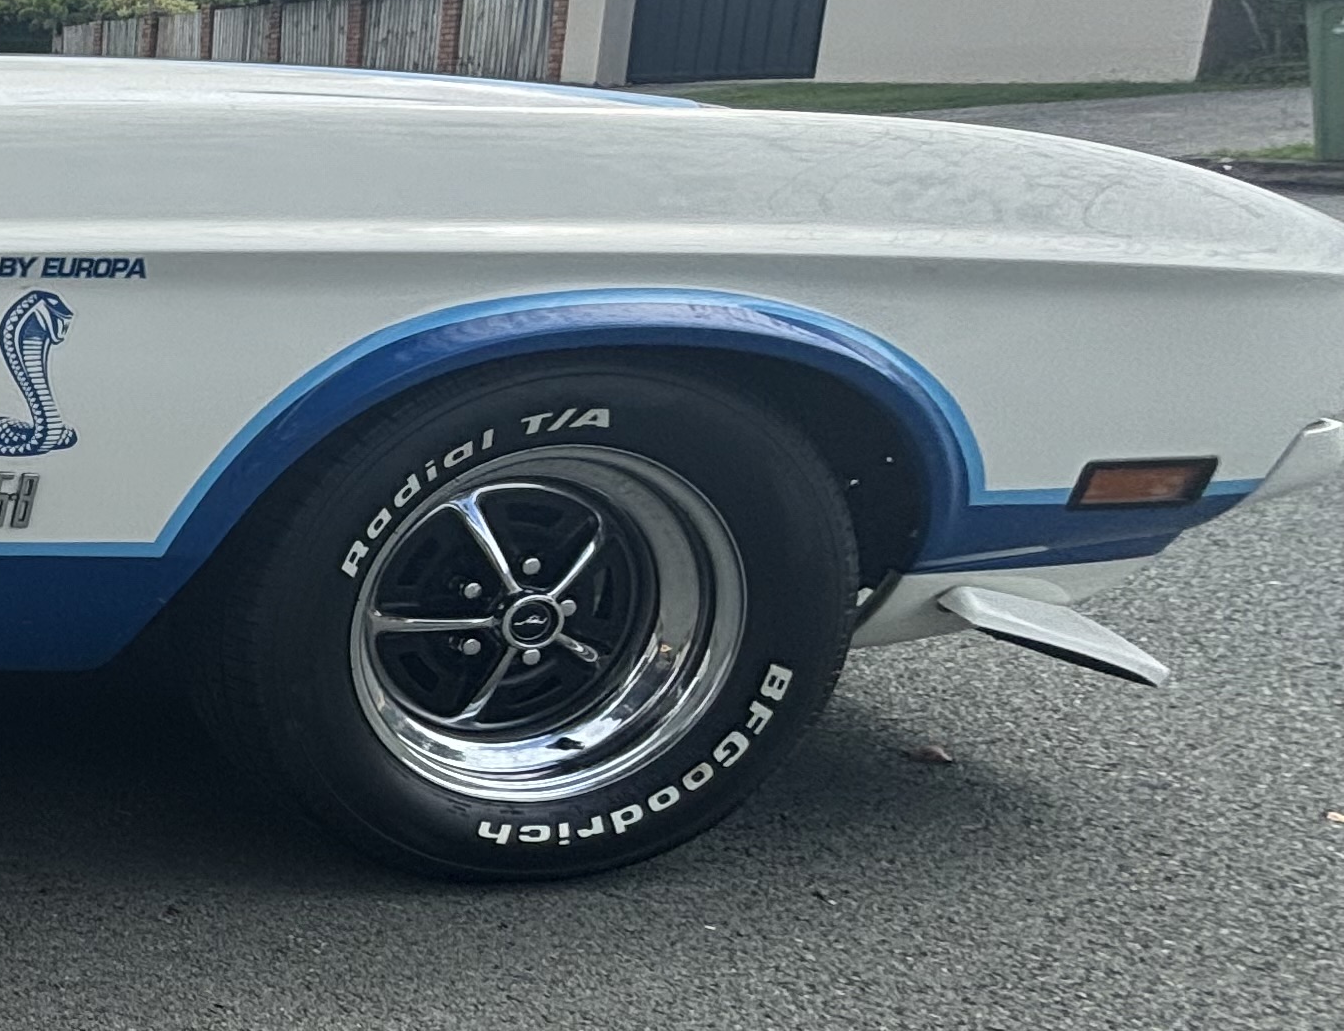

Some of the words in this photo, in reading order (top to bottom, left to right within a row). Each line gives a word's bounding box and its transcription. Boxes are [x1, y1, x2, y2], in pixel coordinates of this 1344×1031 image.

[40, 257, 146, 279] EUROPA
[341, 428, 495, 578] Radial
[521, 408, 610, 435] T/A
[477, 663, 793, 845] BFGoodrich
